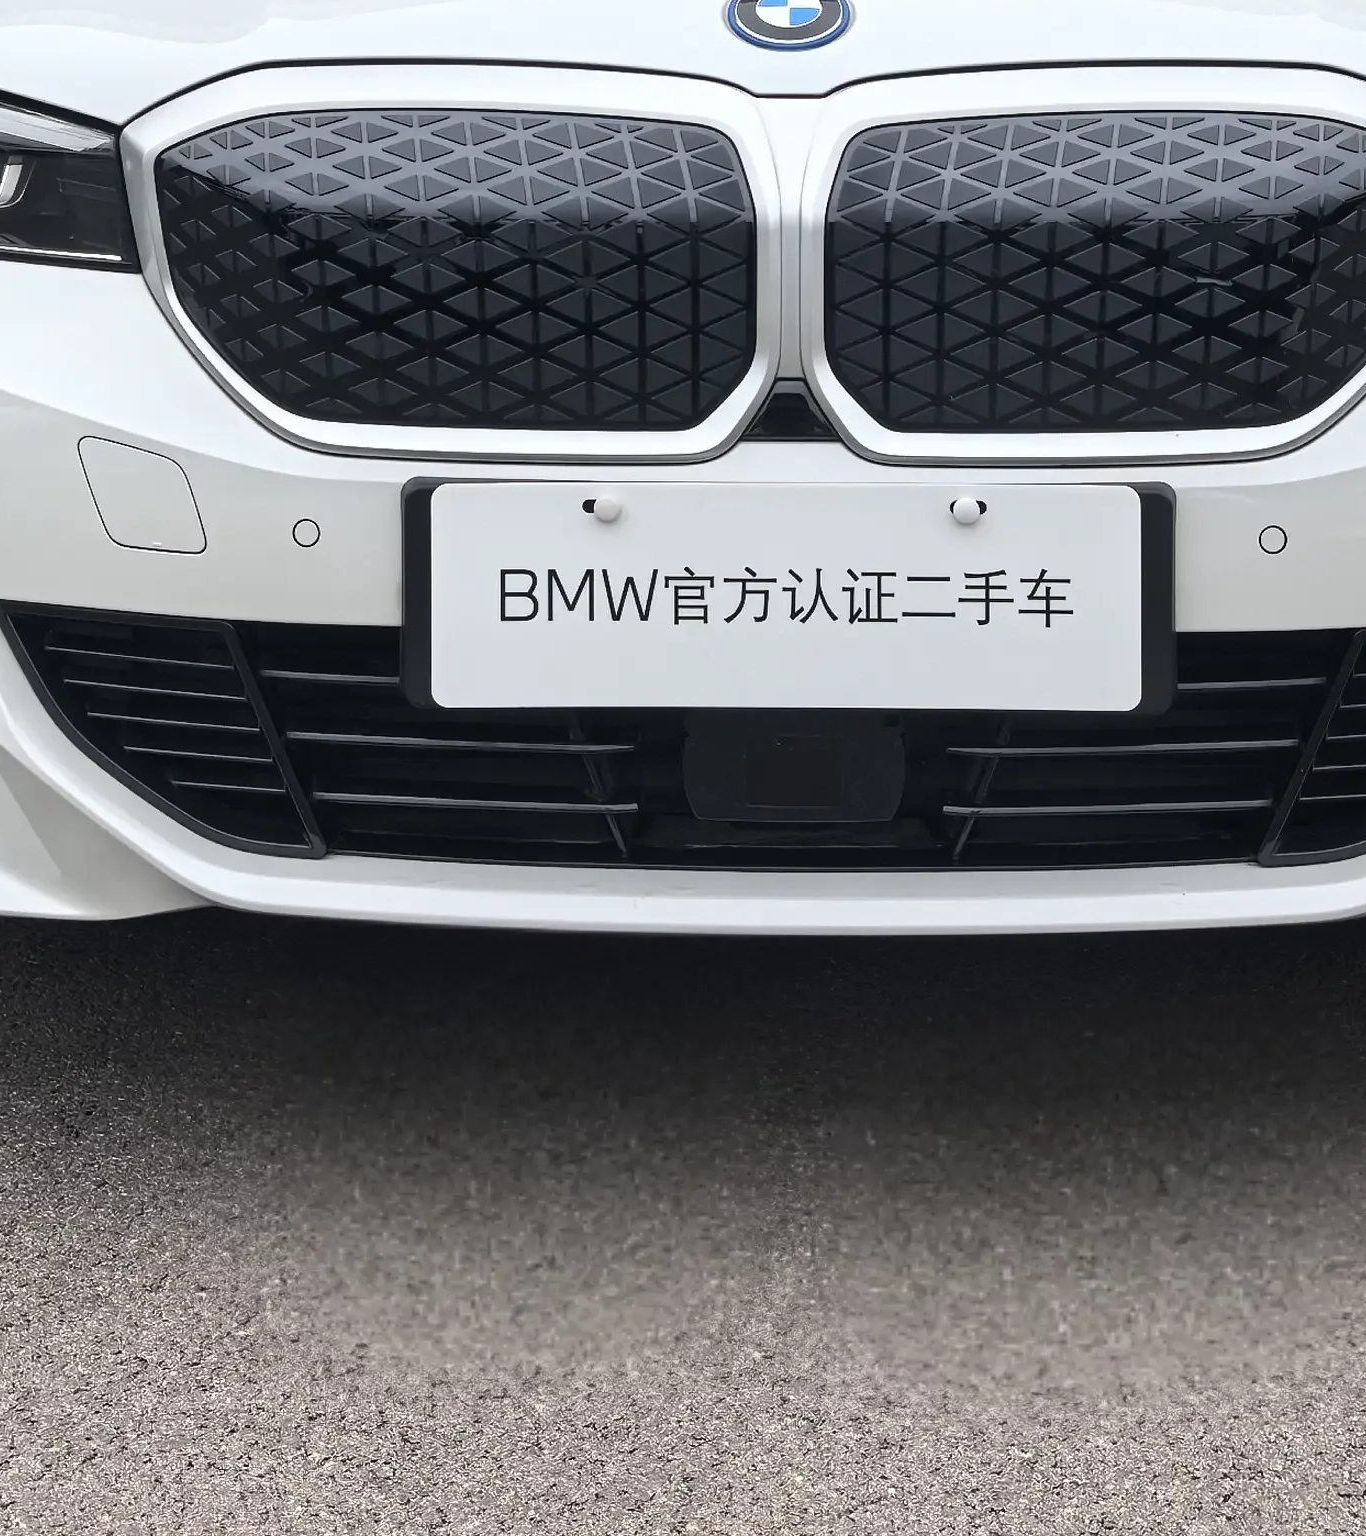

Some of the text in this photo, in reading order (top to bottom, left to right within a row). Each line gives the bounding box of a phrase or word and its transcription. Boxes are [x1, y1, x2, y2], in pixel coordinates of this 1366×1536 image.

[498, 565, 1075, 629] BMW官方认证二手车
